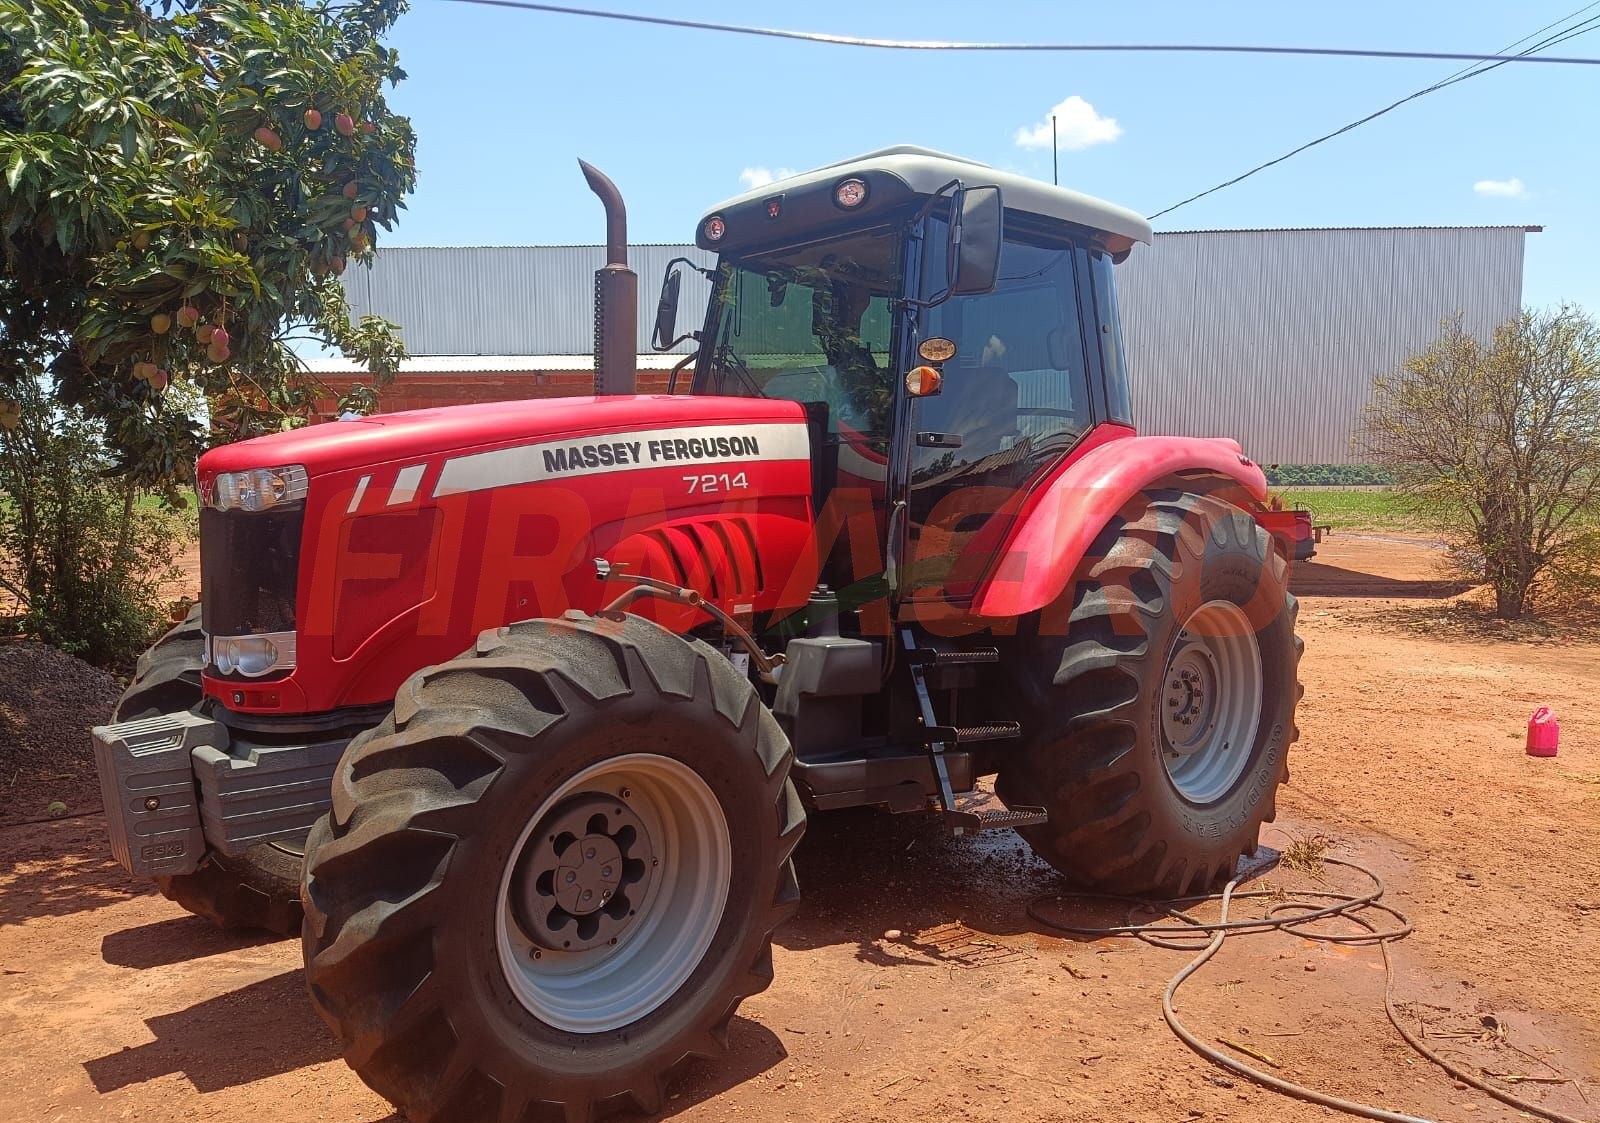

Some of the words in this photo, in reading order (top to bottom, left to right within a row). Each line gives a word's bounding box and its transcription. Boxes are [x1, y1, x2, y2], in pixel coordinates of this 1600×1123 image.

[542, 441, 642, 473] MASSEY
[647, 436, 760, 462] FERGUSON
[682, 472, 749, 494] 7214
